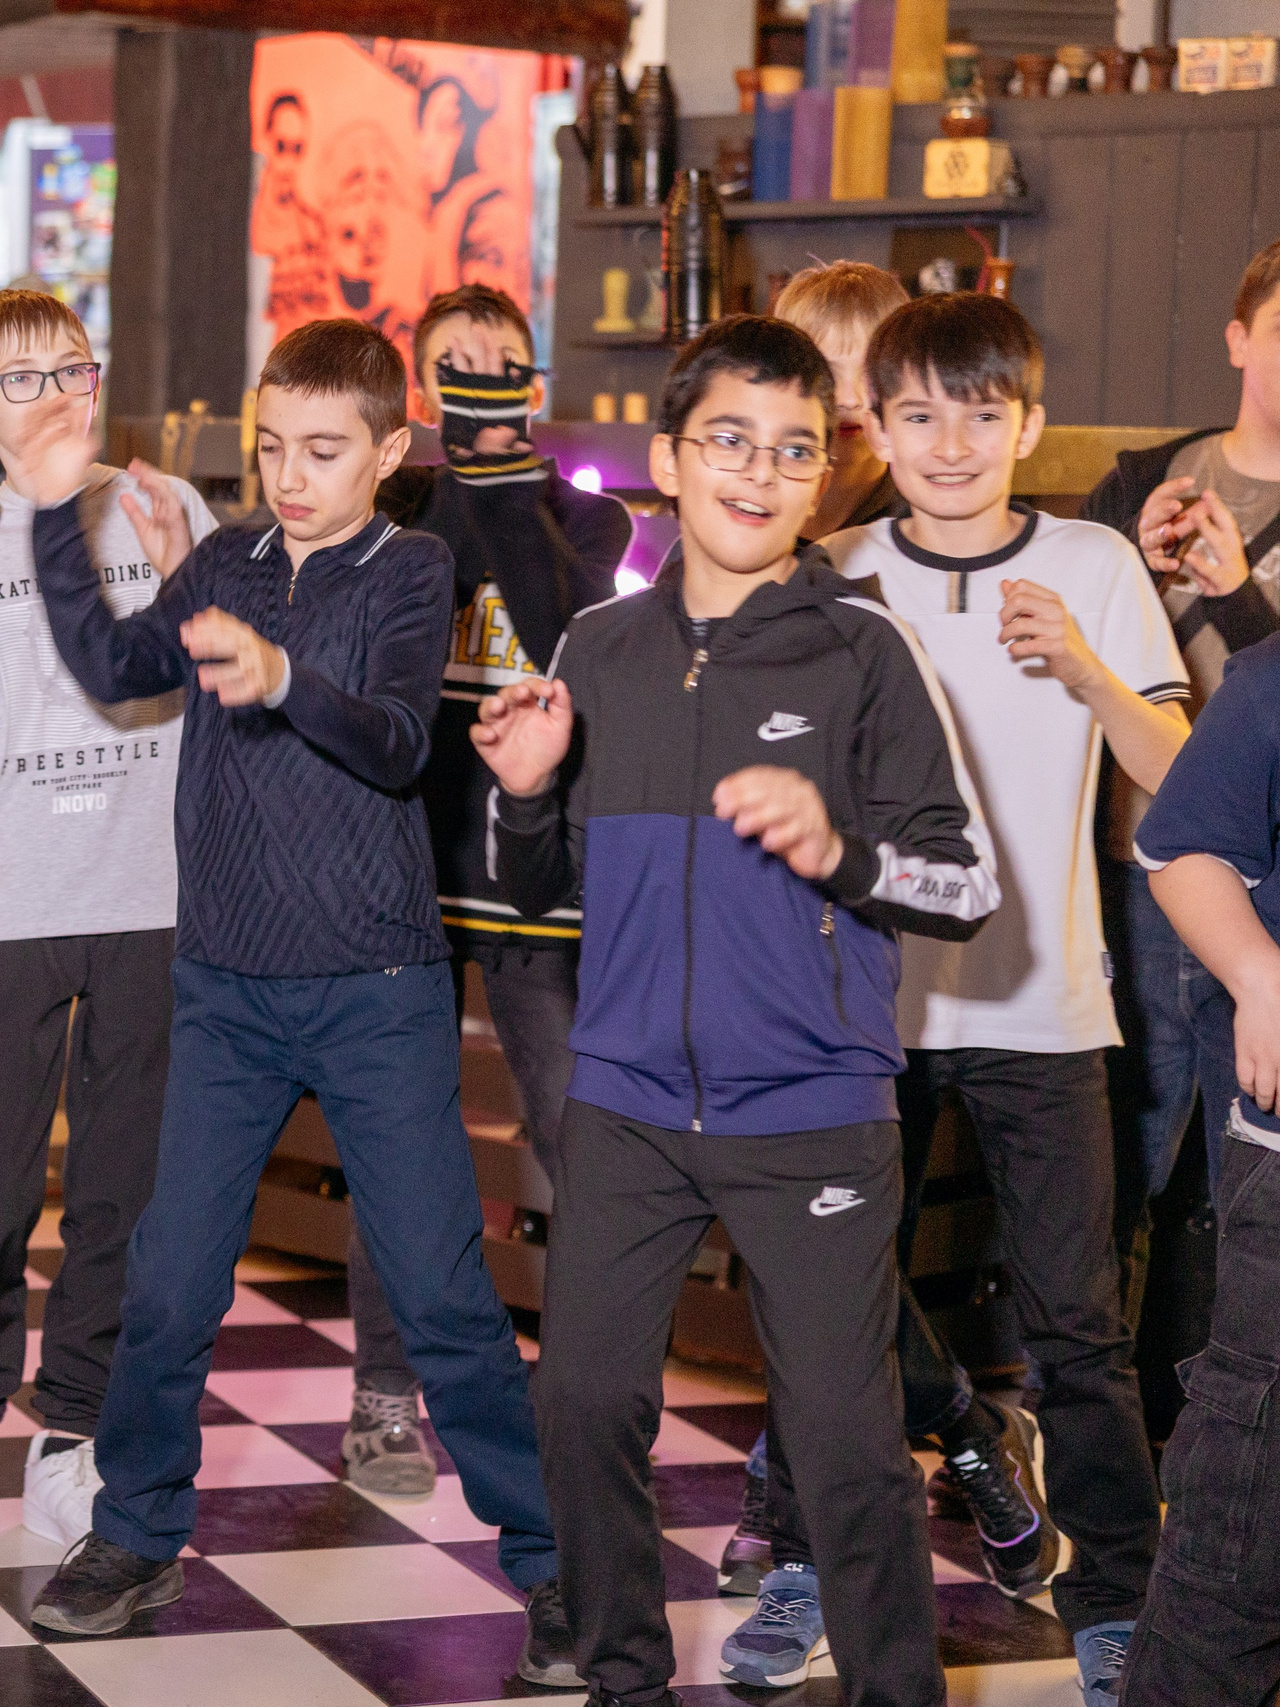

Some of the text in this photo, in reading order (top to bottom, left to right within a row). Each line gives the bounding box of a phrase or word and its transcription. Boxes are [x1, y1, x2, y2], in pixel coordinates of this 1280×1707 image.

[32, 779, 47, 787] NEW
[69, 774, 87, 782] CITY
[52, 793, 107, 815] INOVO
